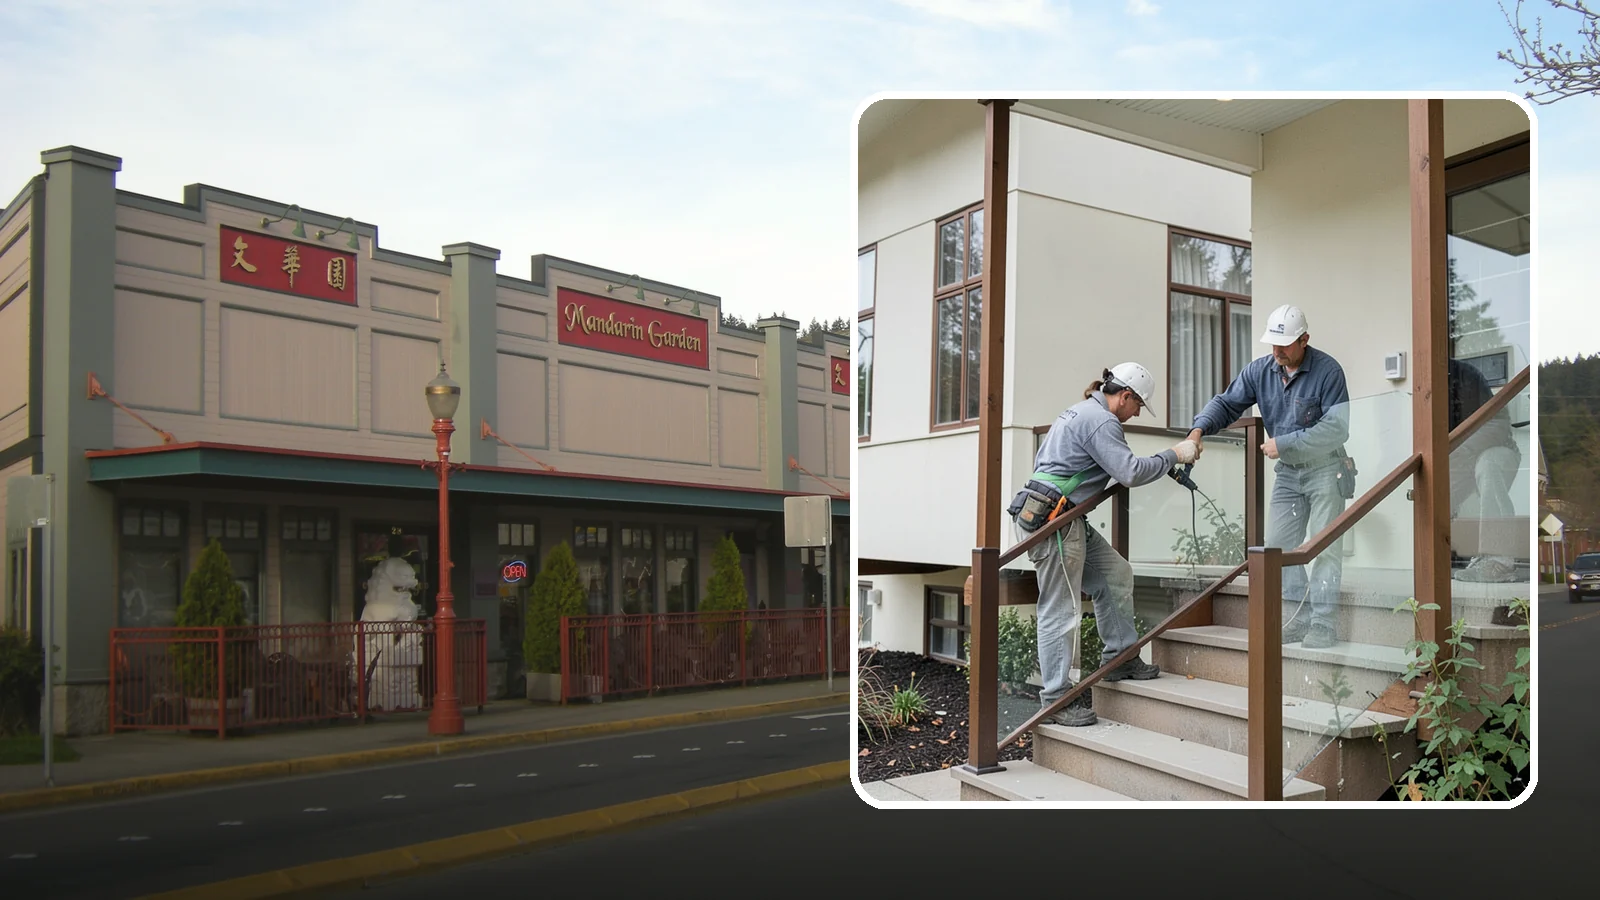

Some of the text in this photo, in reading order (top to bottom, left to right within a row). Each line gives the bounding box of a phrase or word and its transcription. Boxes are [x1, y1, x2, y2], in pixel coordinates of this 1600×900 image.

[231, 236, 346, 290] 文華園
[564, 302, 701, 352] Mandarin Garden
[503, 565, 527, 578] OPEN
